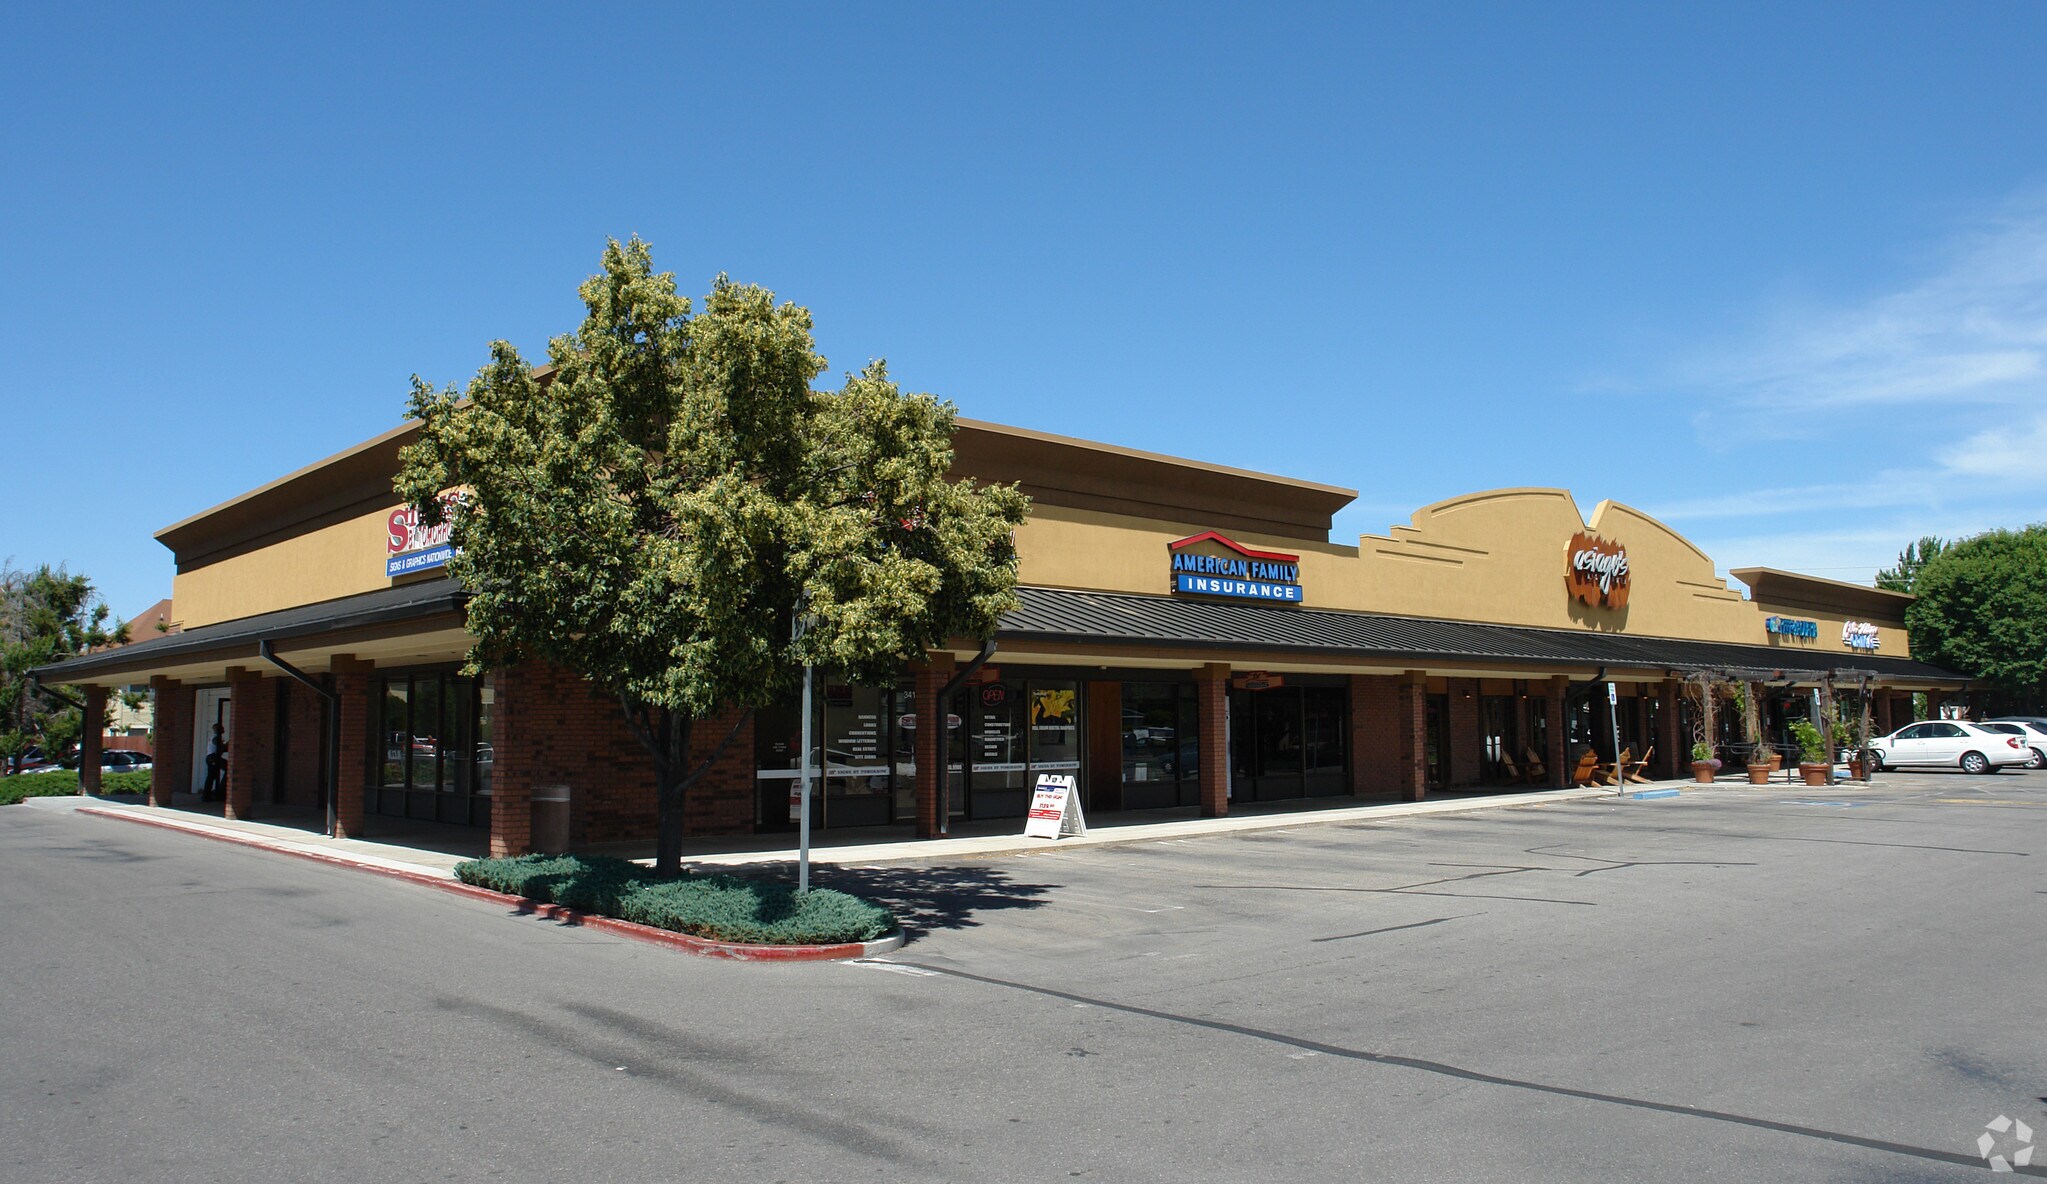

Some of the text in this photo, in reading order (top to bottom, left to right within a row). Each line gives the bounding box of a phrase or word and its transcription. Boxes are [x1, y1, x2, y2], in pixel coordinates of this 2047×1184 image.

[389, 561, 402, 572] SIGNS
[402, 560, 405, 569] &
[405, 555, 426, 569] GRAPHICS
[426, 549, 453, 564] NATIONWIDE
[1173, 554, 1298, 581] AMERICAN FAMILY
[1188, 578, 1294, 599] INSURANCE
[982, 689, 1005, 701] OPEN
